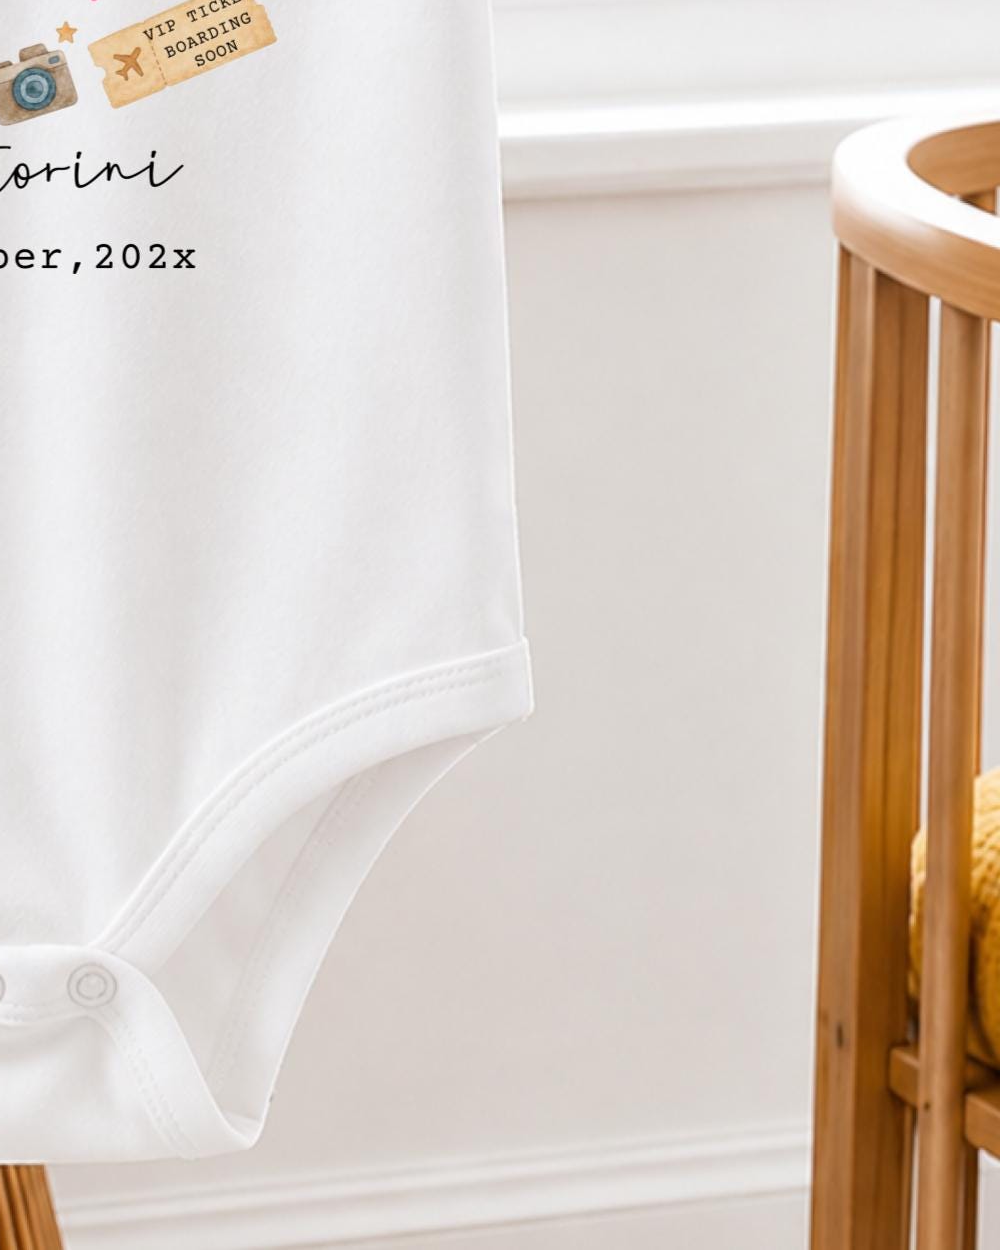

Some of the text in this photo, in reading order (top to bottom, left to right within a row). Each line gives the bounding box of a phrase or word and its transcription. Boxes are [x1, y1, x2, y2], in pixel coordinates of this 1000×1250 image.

[142, 19, 176, 41] VIP
[164, 12, 252, 58] BOARDING
[194, 39, 239, 67] SOON
